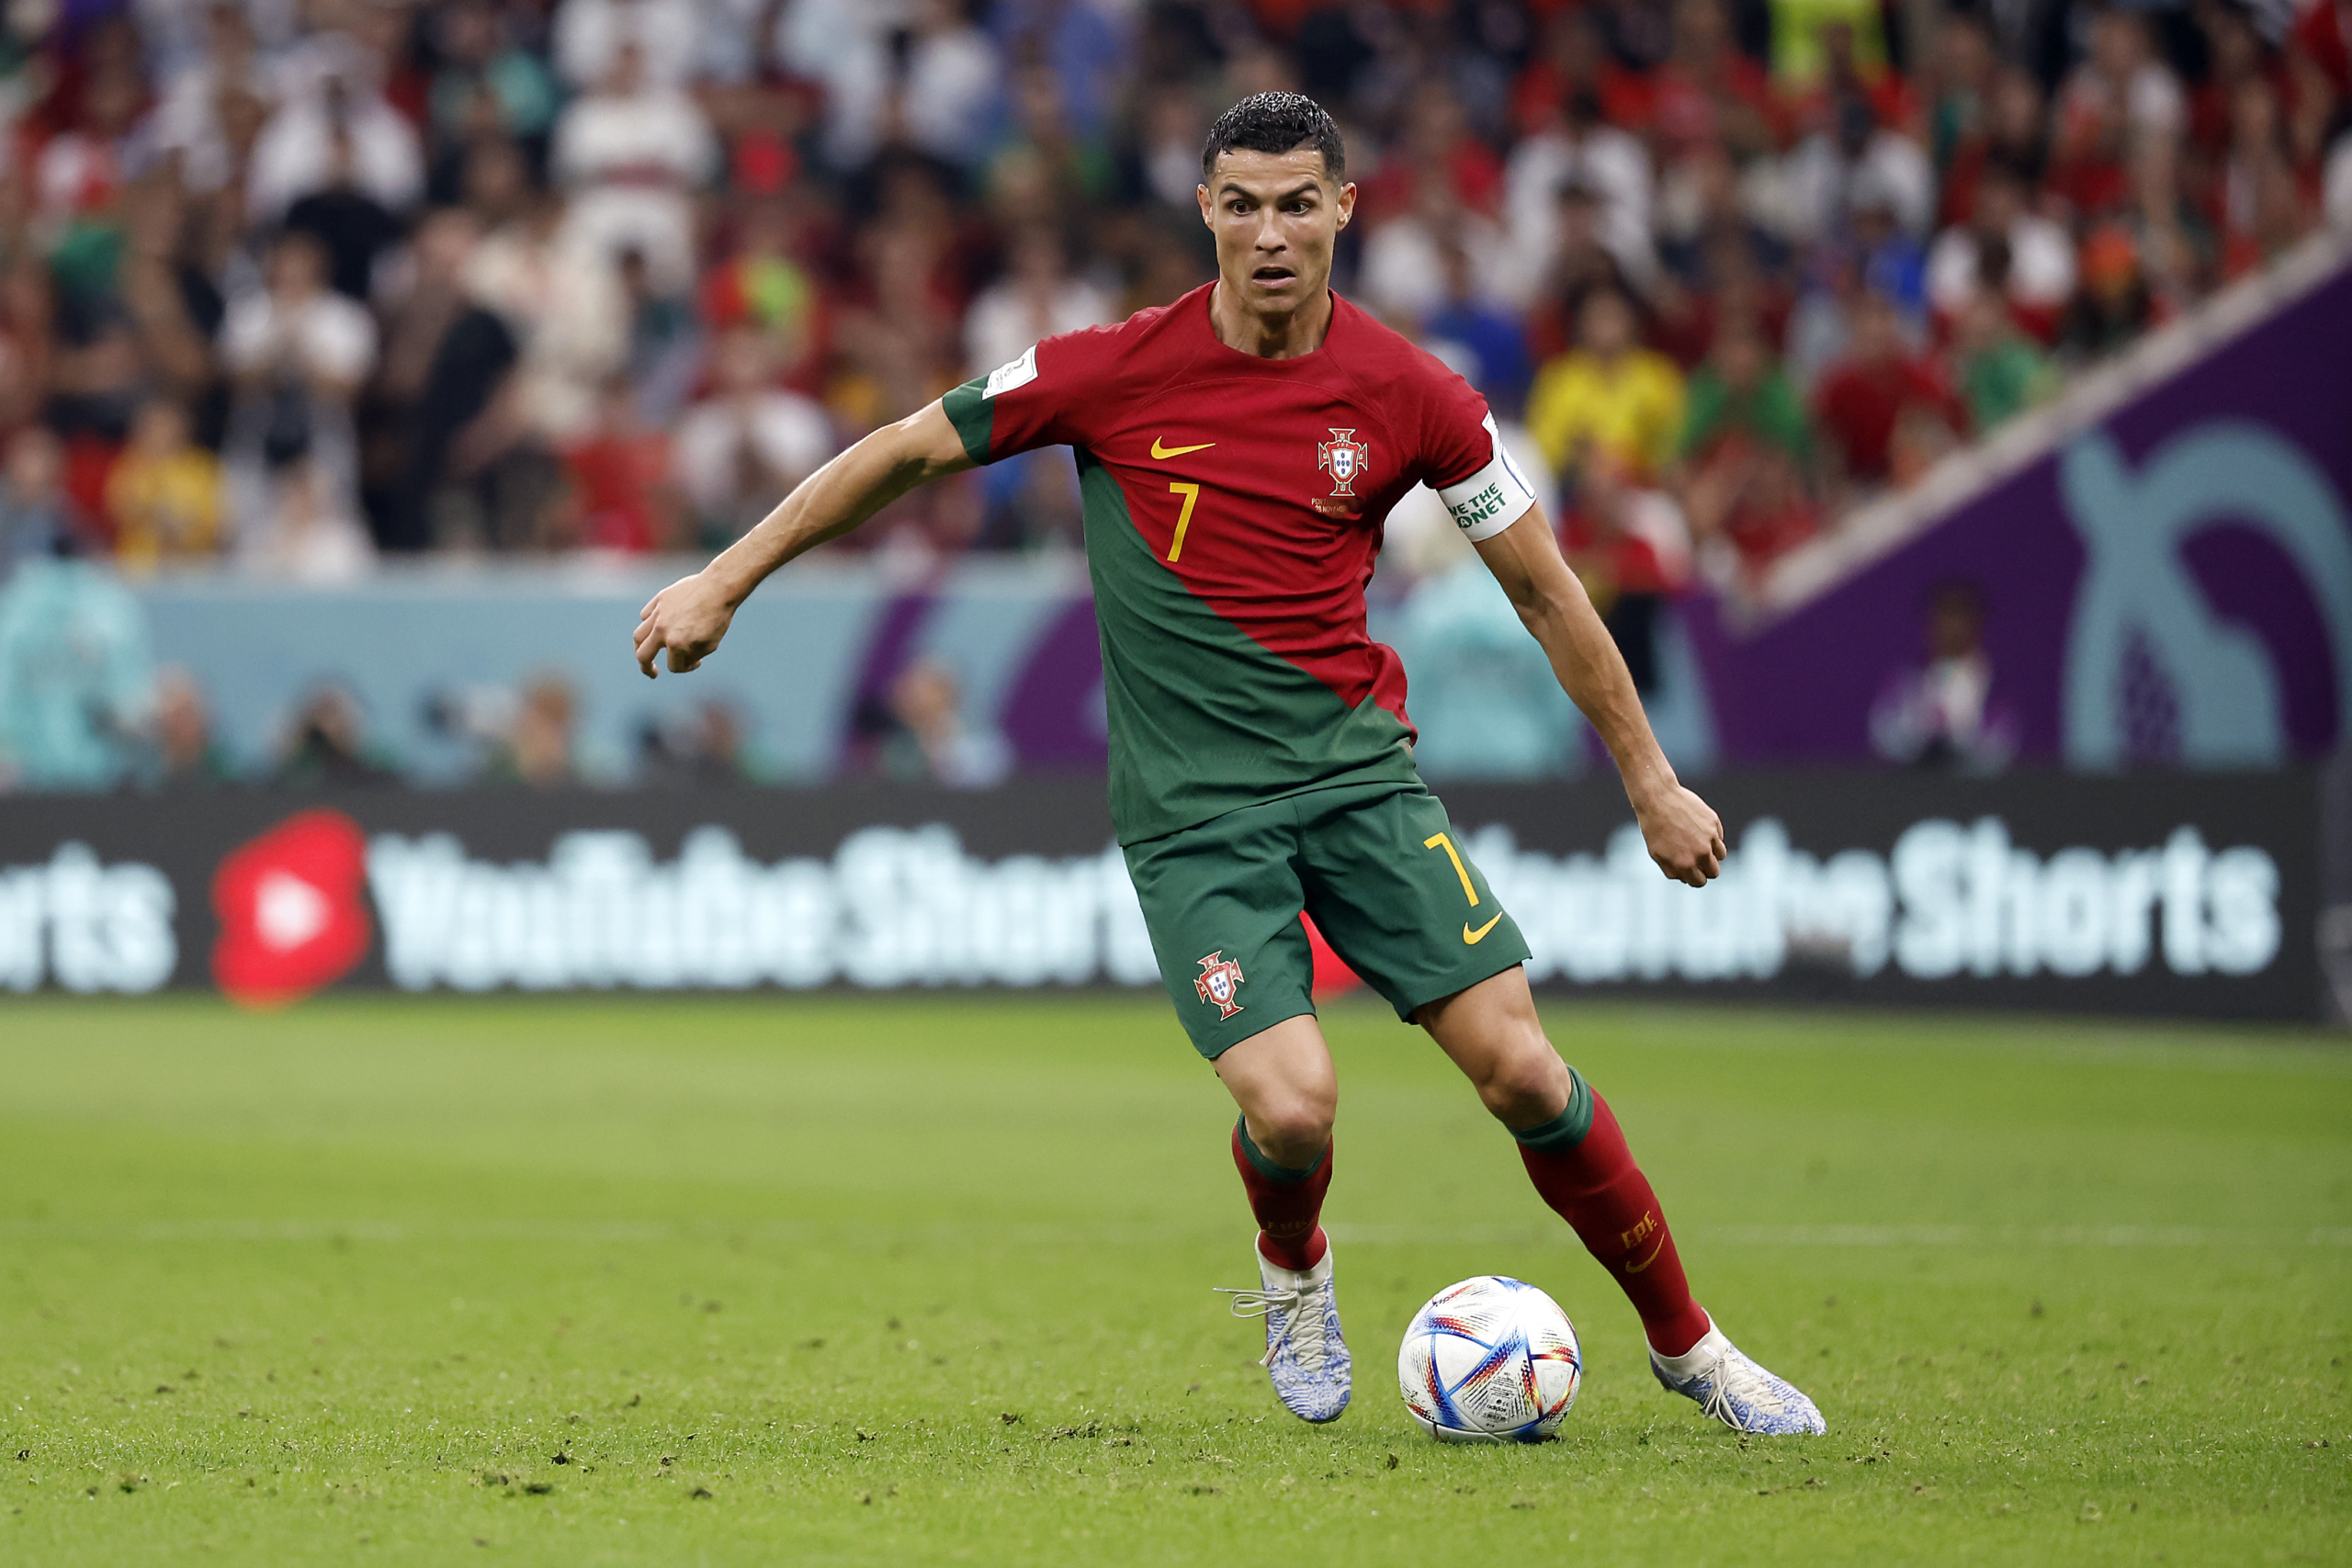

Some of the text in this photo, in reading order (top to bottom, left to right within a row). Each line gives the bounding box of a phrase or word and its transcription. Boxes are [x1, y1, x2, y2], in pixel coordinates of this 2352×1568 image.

[1168, 482, 1199, 562] 7
[1468, 481, 1498, 508] THE
[366, 829, 832, 987] YouTube
[1425, 832, 1481, 908] 7
[1891, 819, 2278, 979] Shorts
